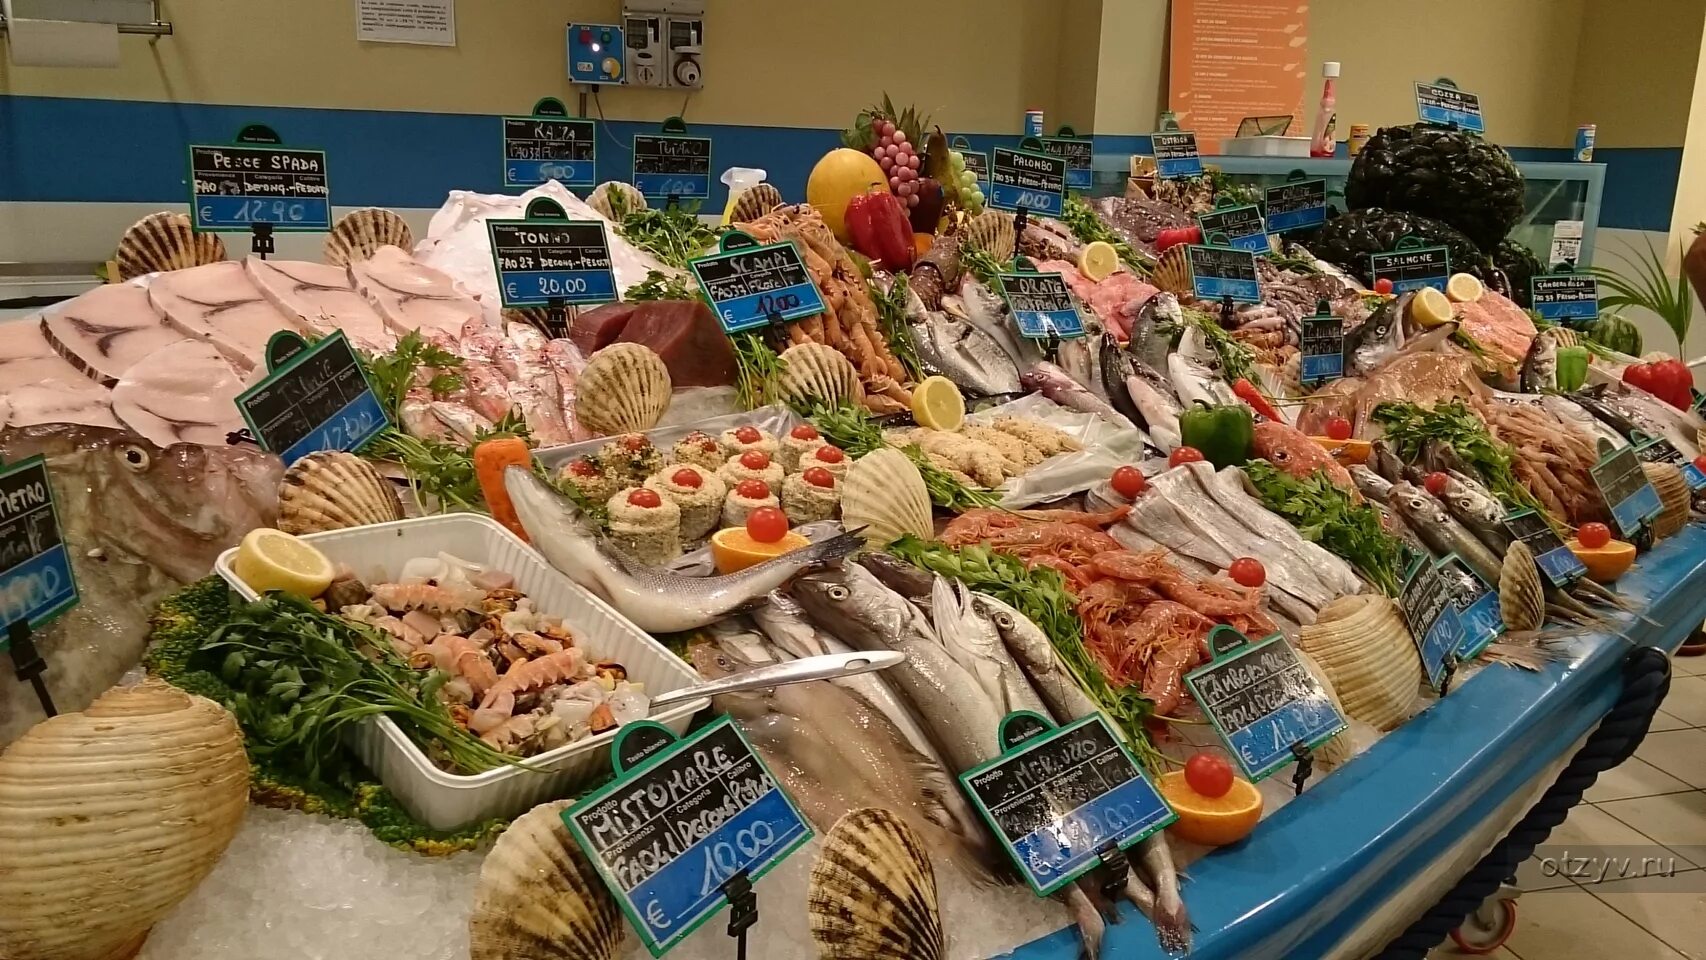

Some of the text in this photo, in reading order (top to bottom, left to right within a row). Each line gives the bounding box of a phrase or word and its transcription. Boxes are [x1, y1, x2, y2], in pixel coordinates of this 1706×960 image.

[271, 155, 319, 172] SPADA
[1013, 154, 1053, 171] PALOMBO
[499, 257, 518, 270] FAO
[519, 256, 535, 269] 27
[626, 752, 644, 764] Tasto
[973, 768, 1004, 787] Prodotto
[994, 792, 1036, 816] Provenienza
[1096, 751, 1119, 766] Calibro
[582, 798, 618, 826] Prodotto
[607, 761, 752, 860] Provenienza Categoria Calibro
[646, 899, 672, 929] €
